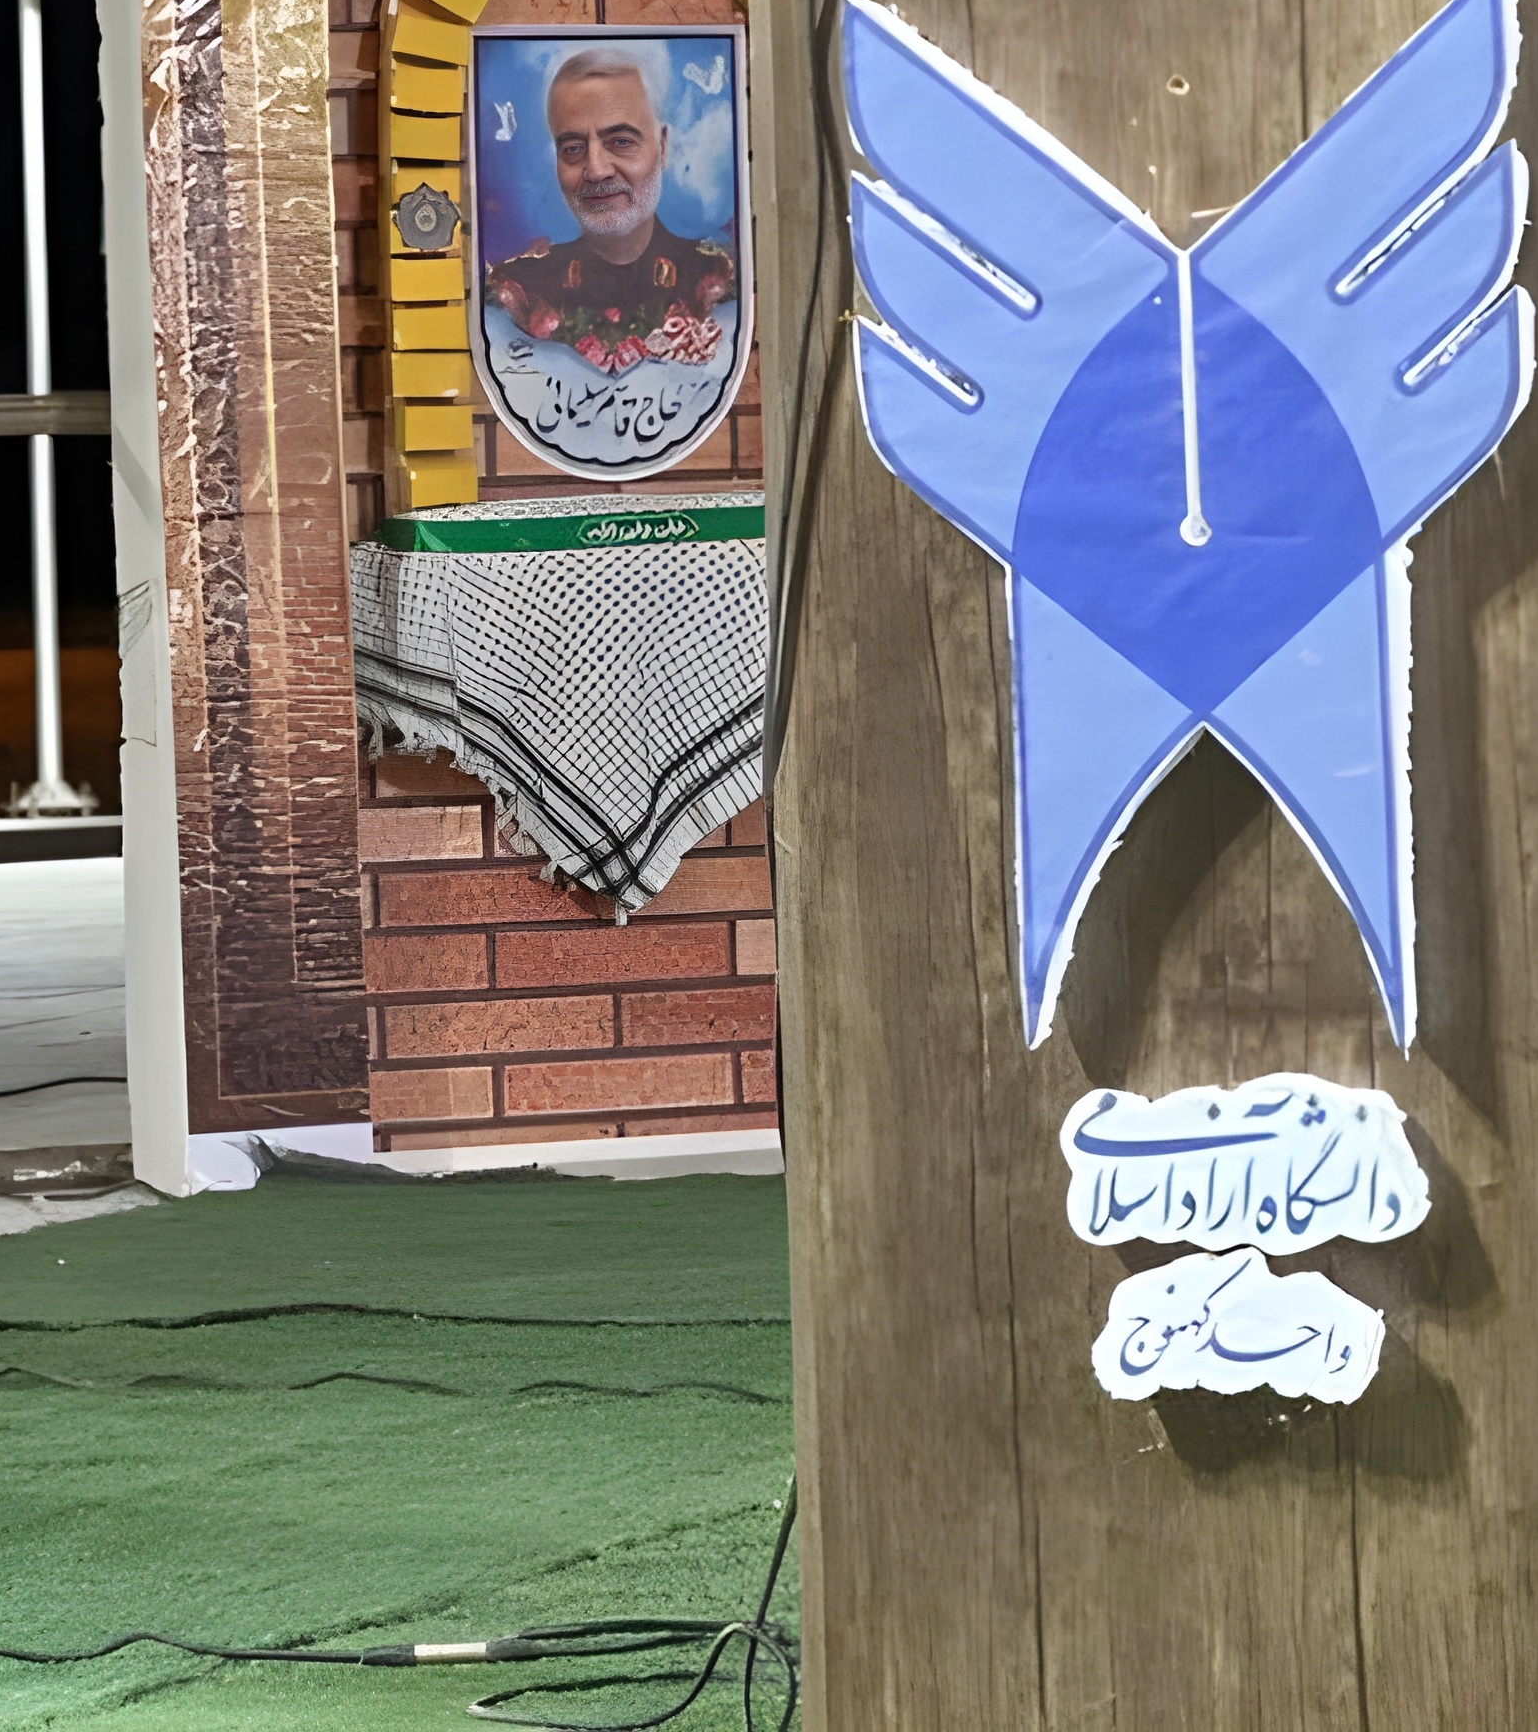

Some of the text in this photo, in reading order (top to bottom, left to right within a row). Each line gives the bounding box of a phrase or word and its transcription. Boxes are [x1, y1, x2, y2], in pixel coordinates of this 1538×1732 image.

[1073, 1092, 1279, 1236] اسلامی
[1255, 1093, 1401, 1235] دانشگاه
[1196, 1322, 1351, 1374] واحد
